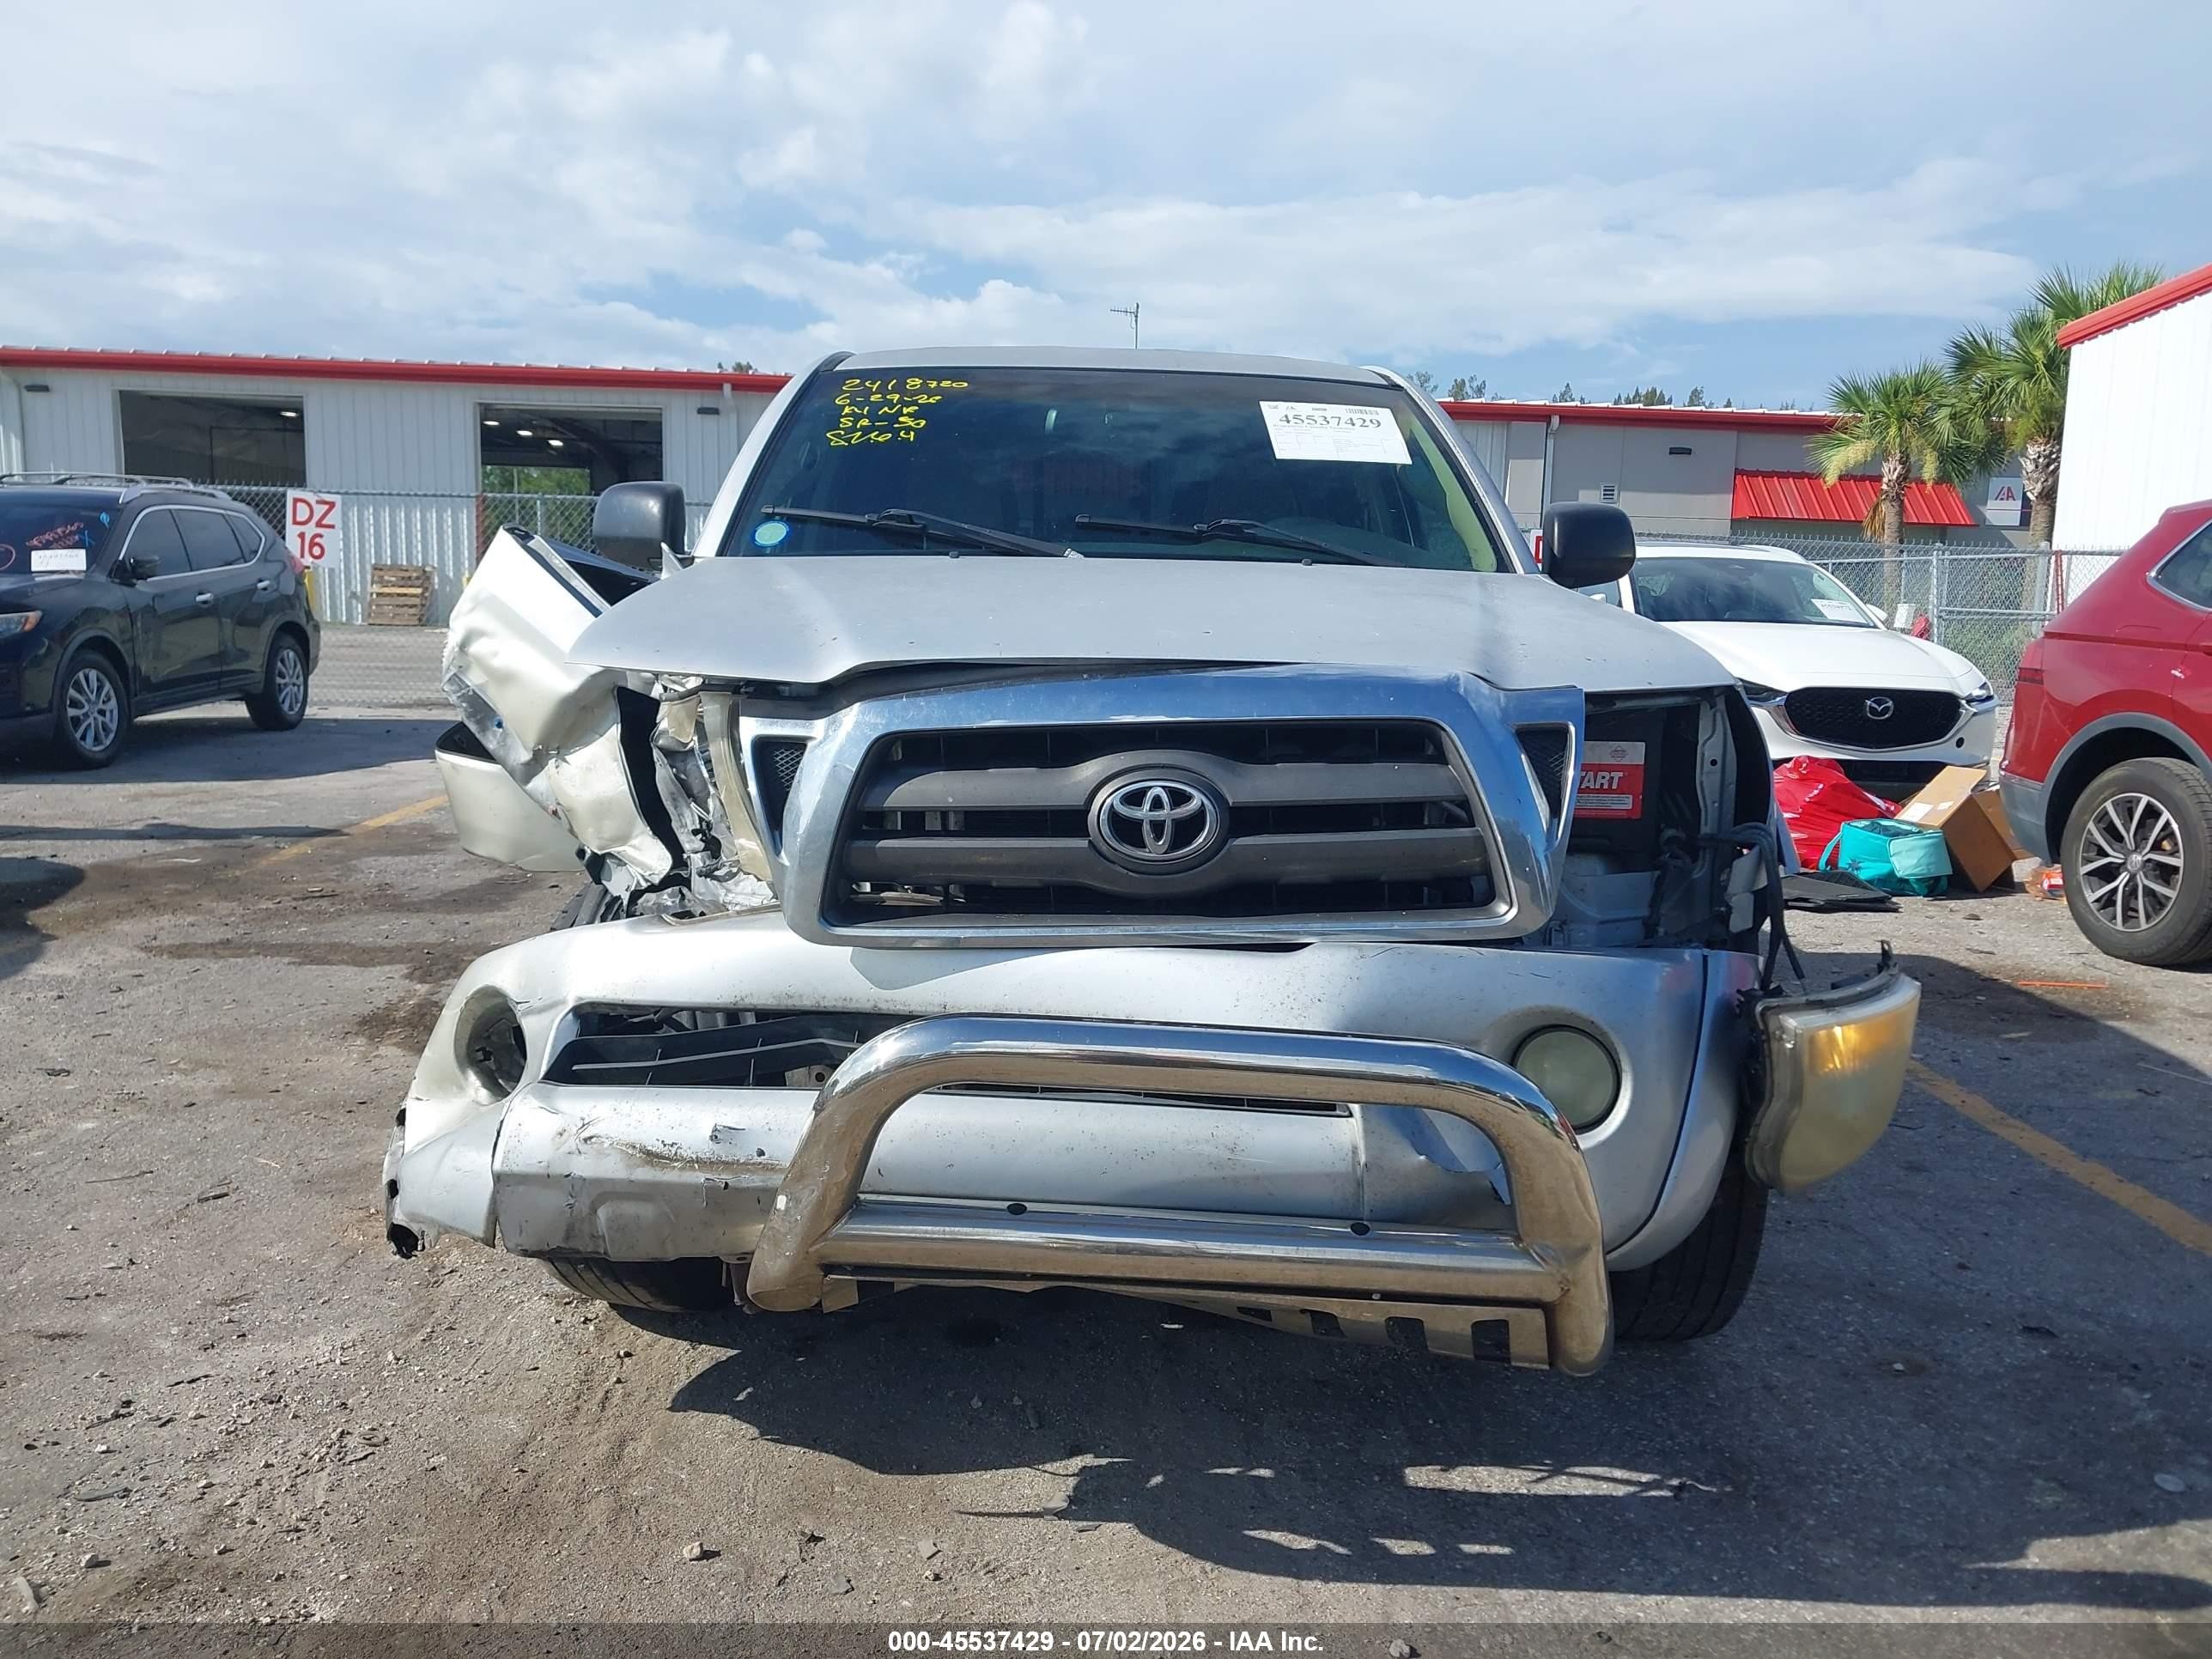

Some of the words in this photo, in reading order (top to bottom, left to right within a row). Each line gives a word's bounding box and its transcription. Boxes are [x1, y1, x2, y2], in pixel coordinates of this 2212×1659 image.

[1279, 413, 1382, 428] 45537429
[292, 497, 337, 529] DZ
[297, 532, 325, 560] 16
